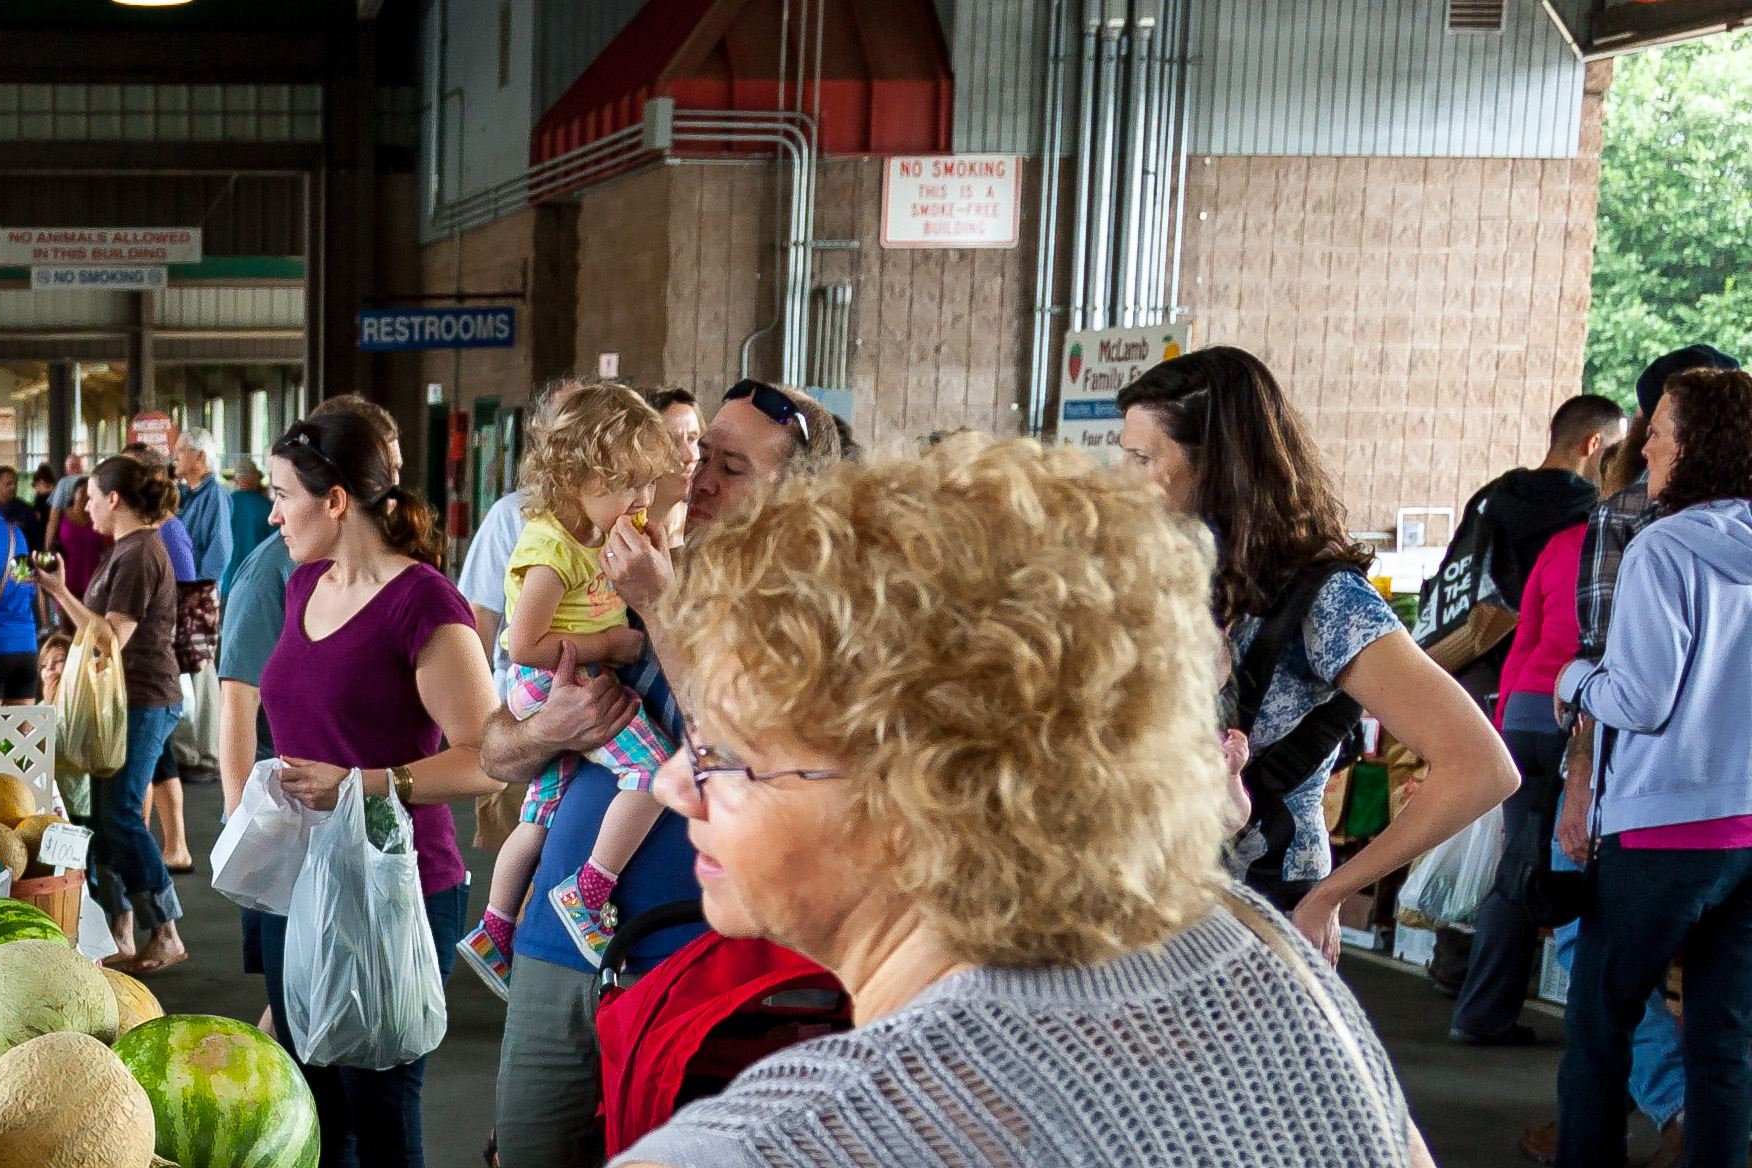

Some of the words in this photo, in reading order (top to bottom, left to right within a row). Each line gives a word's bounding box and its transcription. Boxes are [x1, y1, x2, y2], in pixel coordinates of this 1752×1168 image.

[900, 160, 923, 178] NO
[932, 160, 1006, 178] SMOKING
[918, 184, 948, 200] THIS
[959, 184, 974, 199] IS
[986, 185, 994, 198] A
[911, 202, 1000, 218] SMOKE-FREE
[923, 220, 986, 235] BUILDING
[8, 231, 33, 244] NO
[36, 231, 108, 244] ANIMALS
[112, 231, 191, 244] ALLOWED
[32, 248, 49, 260] IN
[53, 248, 87, 260] THIS
[91, 248, 167, 260] BUILDING
[53, 269, 76, 283] NO
[78, 269, 145, 283] SMOKING
[362, 313, 511, 344] RESTROOMS
[1099, 336, 1150, 363] McLamb
[1443, 571, 1472, 603] THE
